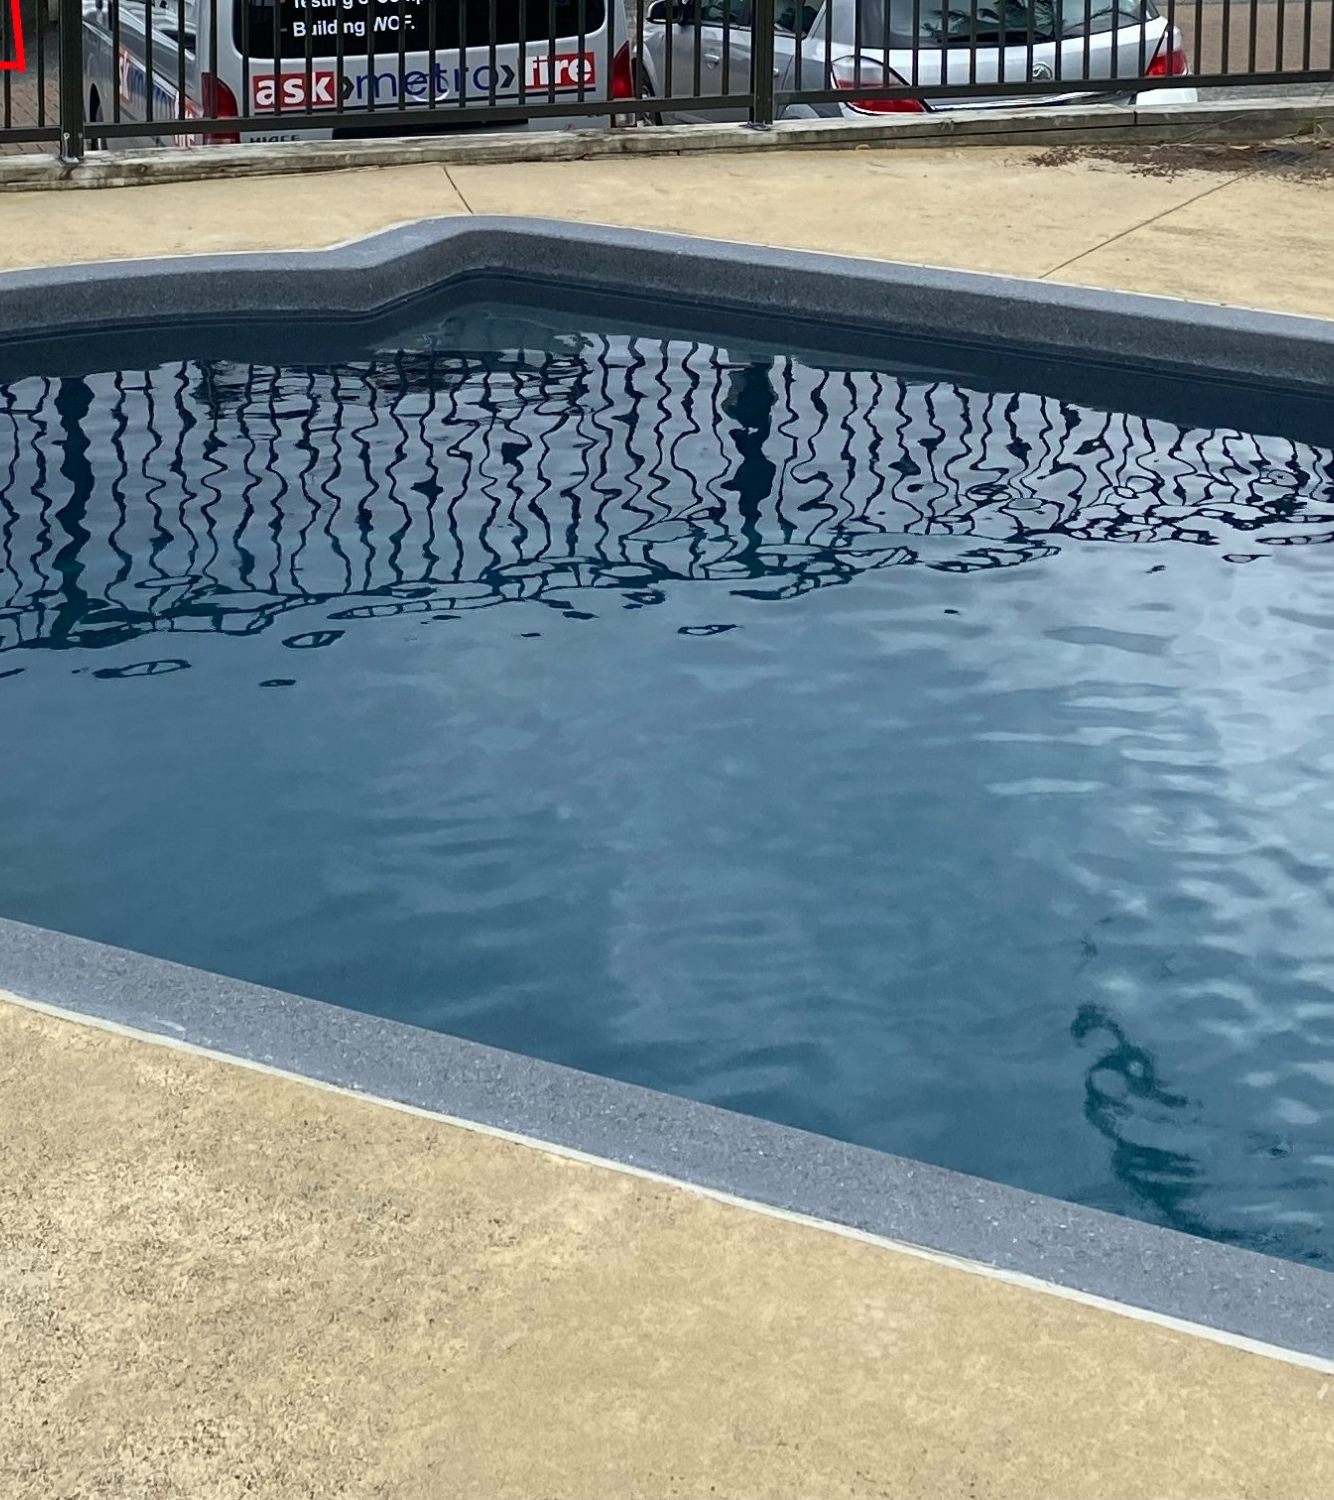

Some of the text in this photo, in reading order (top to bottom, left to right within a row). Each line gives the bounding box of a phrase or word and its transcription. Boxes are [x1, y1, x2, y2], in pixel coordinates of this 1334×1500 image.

[292, 19, 366, 37] Bildng
[255, 71, 334, 106] ask
[523, 54, 593, 88] fire
